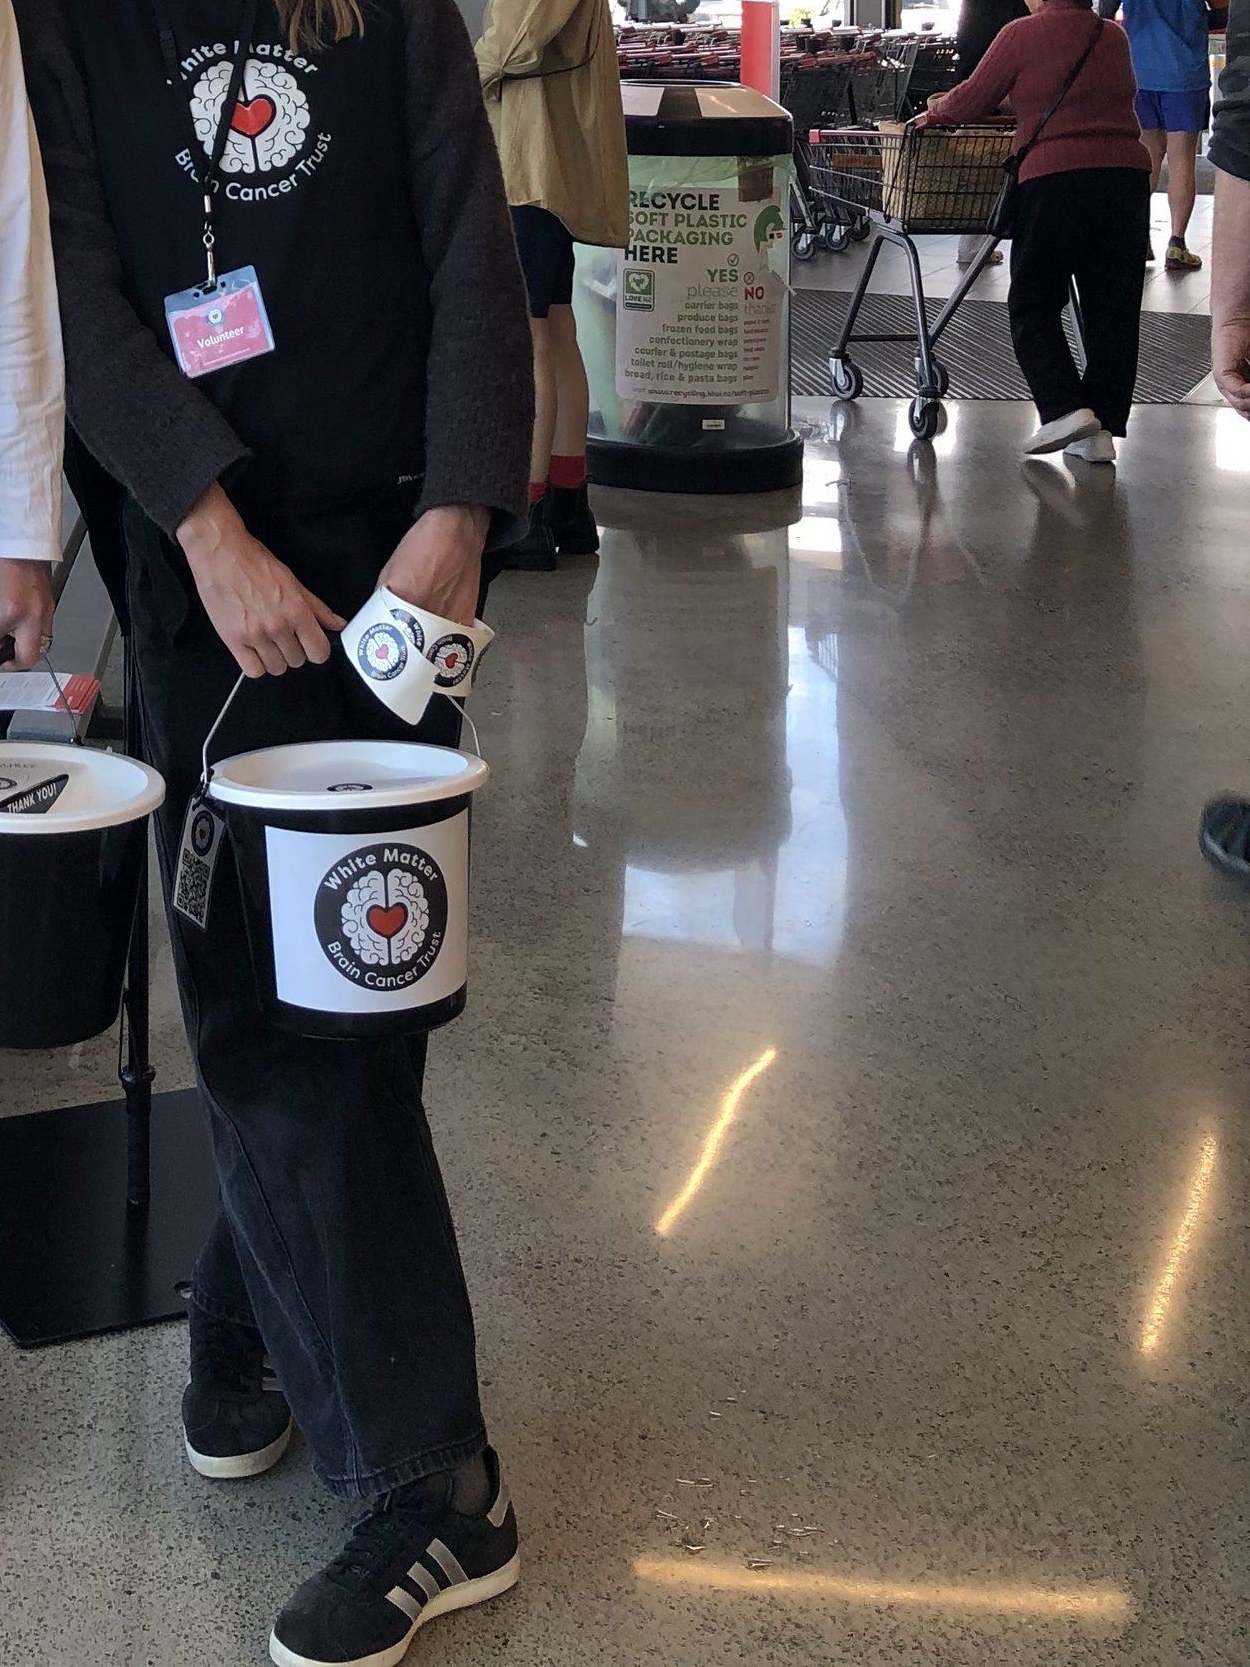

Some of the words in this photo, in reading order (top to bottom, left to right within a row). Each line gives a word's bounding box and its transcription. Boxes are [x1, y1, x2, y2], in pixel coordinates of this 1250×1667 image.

[167, 43, 227, 85] hite
[225, 174, 298, 201] Cancer
[295, 132, 332, 177] Trust
[629, 190, 720, 211] RECYCLE
[629, 211, 669, 227] SOFT
[674, 213, 748, 229] PLASTIC
[624, 245, 678, 264] HERE
[707, 269, 739, 283] YES
[687, 283, 739, 300] please
[744, 286, 765, 301] NO
[685, 301, 716, 310] carrier
[718, 300, 739, 312] bags
[677, 312, 716, 323] produce
[718, 312, 739, 324] bags
[196, 326, 244, 349] Volunteer
[662, 323, 692, 334] frozen
[694, 324, 716, 334] food
[718, 324, 739, 335] bags
[649, 335, 715, 347] confectionery
[717, 338, 738, 348] wrap
[634, 346, 667, 357] courier
[670, 347, 677, 357] &
[679, 349, 716, 360] postage
[718, 349, 738, 361] bags
[631, 357, 656, 368] toilet
[717, 362, 738, 372] wrap
[656, 371, 675, 381] rice
[678, 371, 685, 381] &
[688, 372, 715, 383] pasta
[717, 372, 738, 384] bags
[7, 795, 36, 814] THANK
[36, 782, 58, 802] YOU!
[324, 853, 378, 891] White
[383, 848, 439, 882] Matter
[327, 941, 361, 980] Brain
[364, 965, 419, 988] Cancer
[416, 931, 442, 969] Trust
